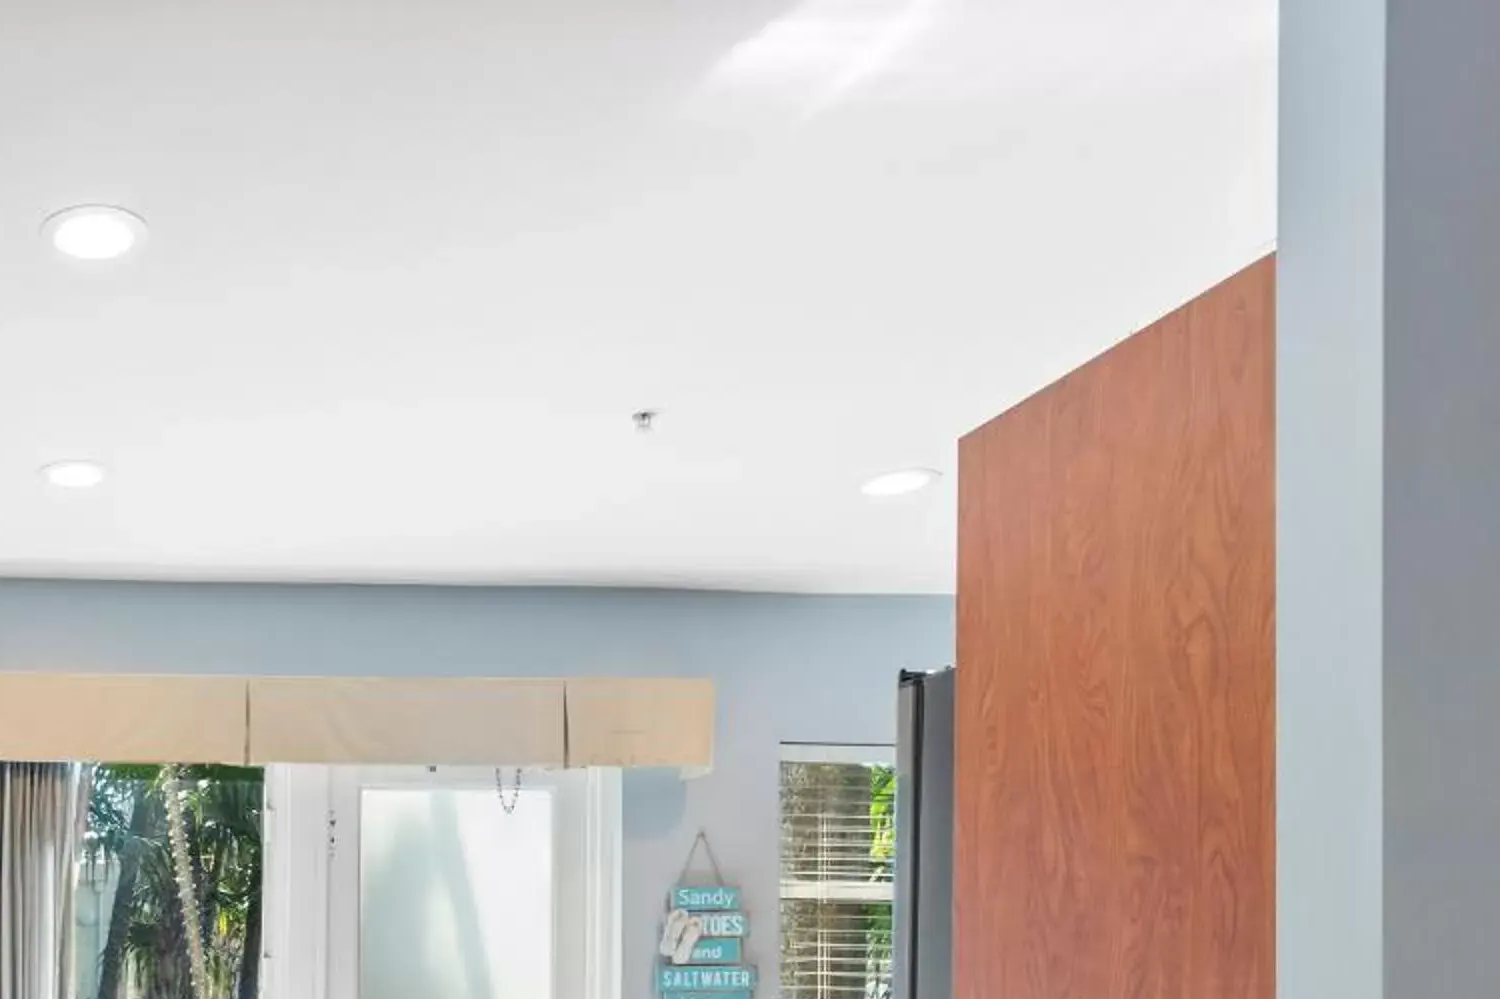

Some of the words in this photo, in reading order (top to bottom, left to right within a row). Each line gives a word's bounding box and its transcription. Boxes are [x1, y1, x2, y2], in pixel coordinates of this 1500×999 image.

[678, 888, 735, 908] Sandy
[701, 915, 744, 935] TOES
[663, 971, 750, 987] SALTWATER
